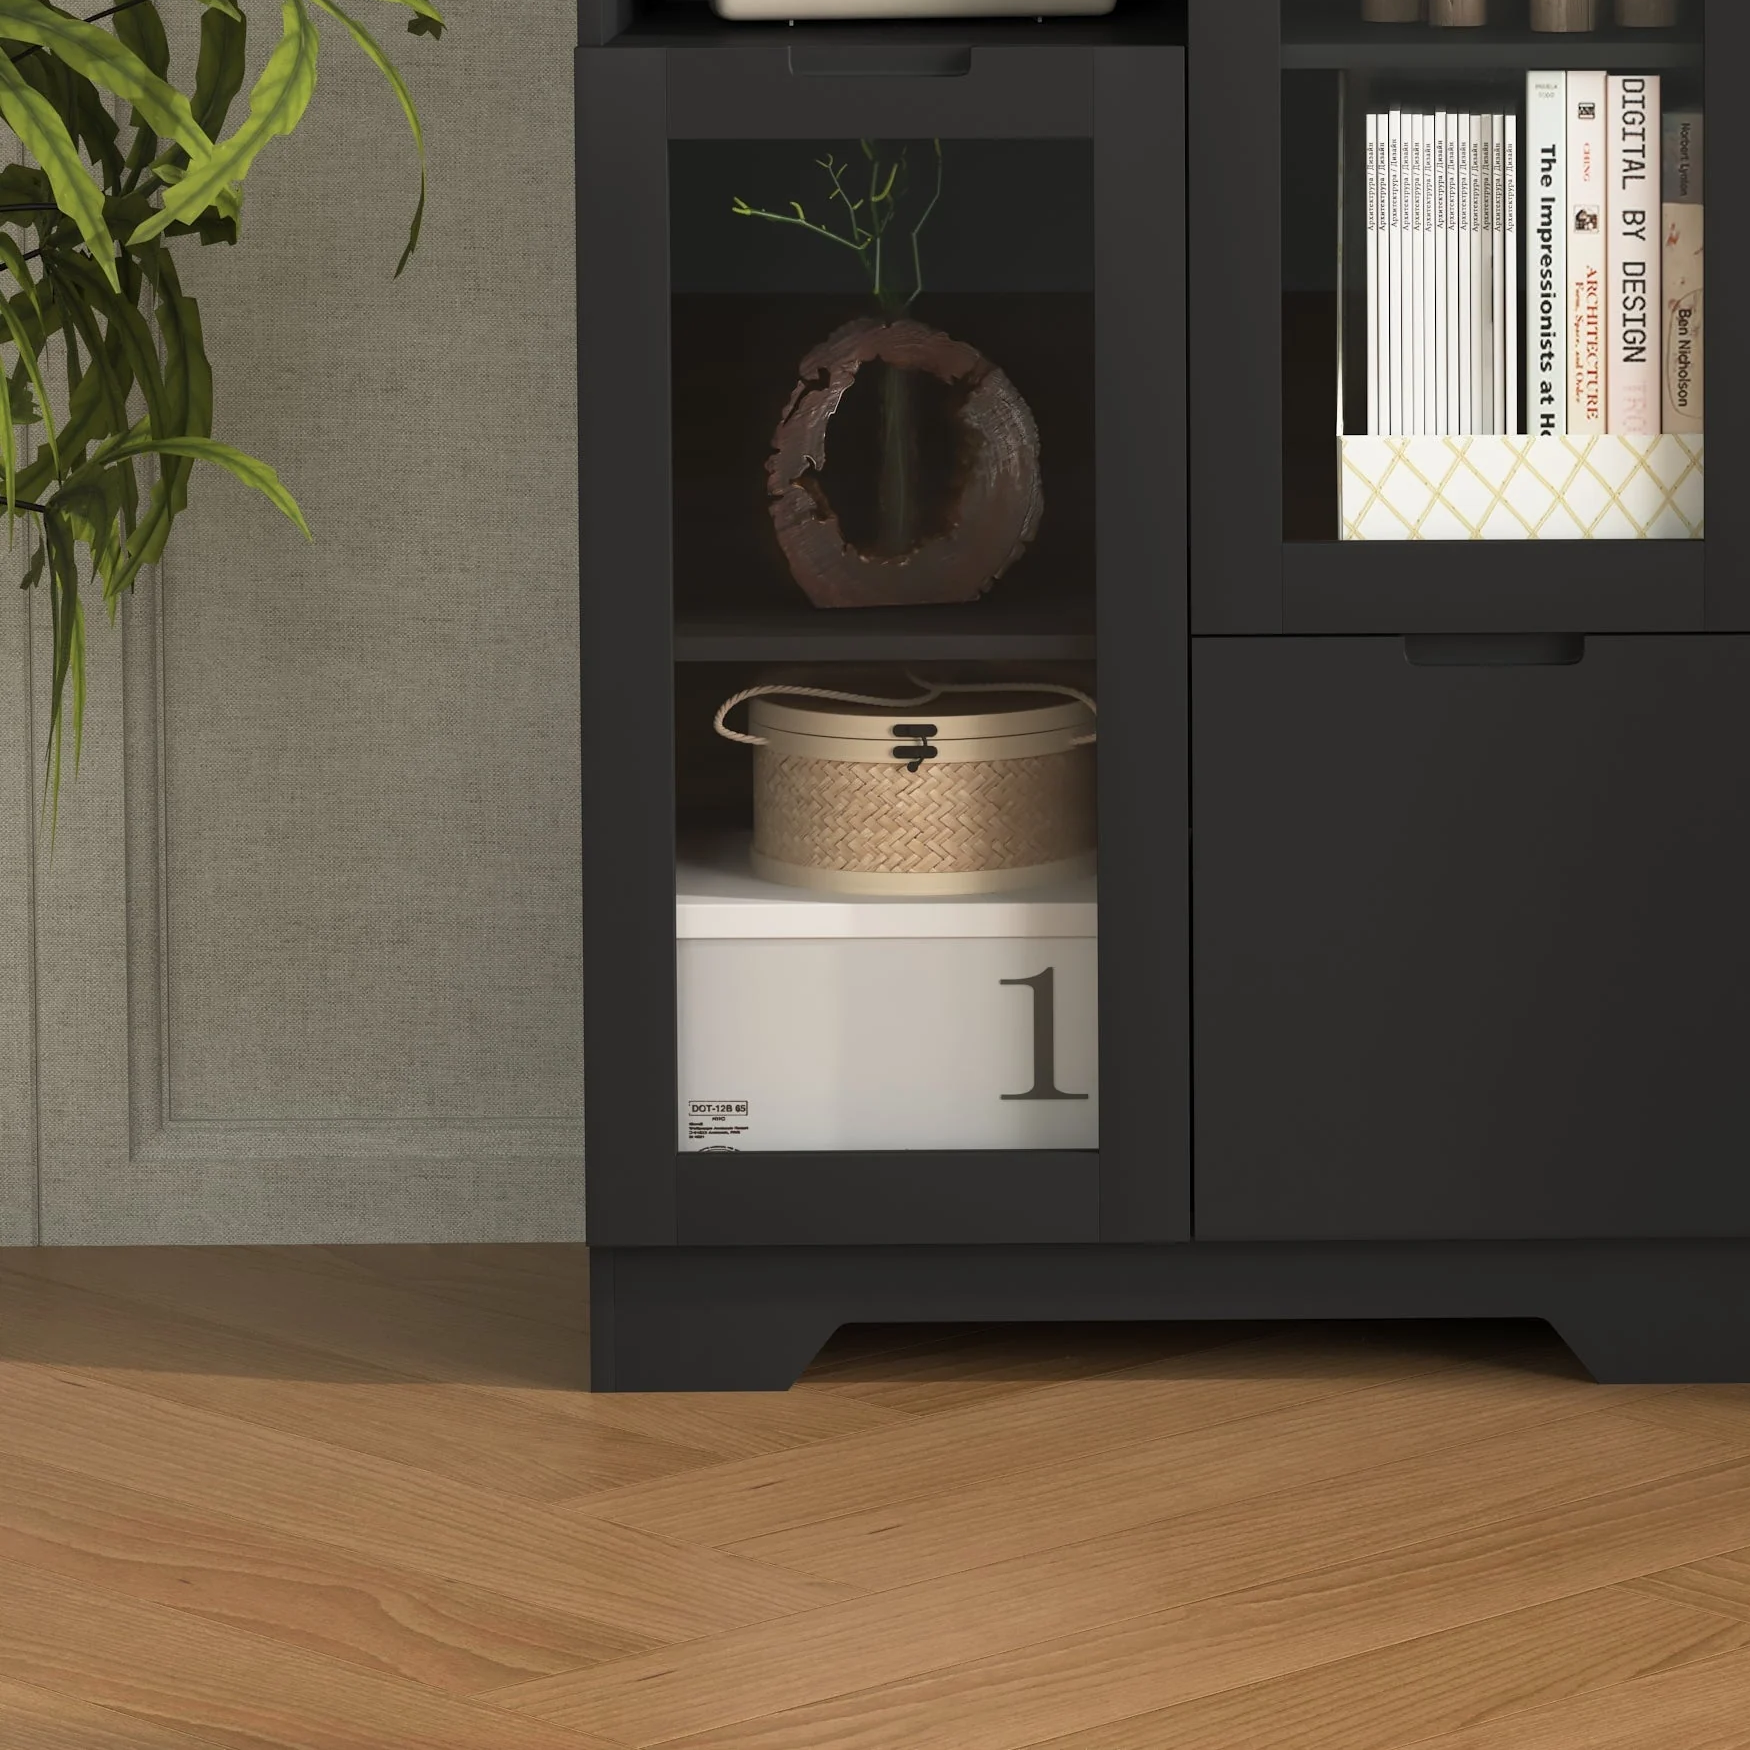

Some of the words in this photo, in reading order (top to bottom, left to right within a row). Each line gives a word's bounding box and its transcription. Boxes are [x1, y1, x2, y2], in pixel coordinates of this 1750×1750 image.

[1621, 78, 1646, 190] DIGITAL
[1680, 122, 1691, 160] Norbert
[1540, 144, 1557, 187] The
[1622, 209, 1646, 242] BY
[1536, 195, 1557, 373] Impressionists
[1622, 261, 1647, 364] DESIGN
[1678, 308, 1691, 335] Ben
[1586, 265, 1599, 420] ARCHITECTURE
[1540, 380, 1555, 404] at
[1678, 339, 1691, 408] Nicholson
[999, 966, 1089, 1100] 1
[691, 1104, 733, 1113] DOT-12B
